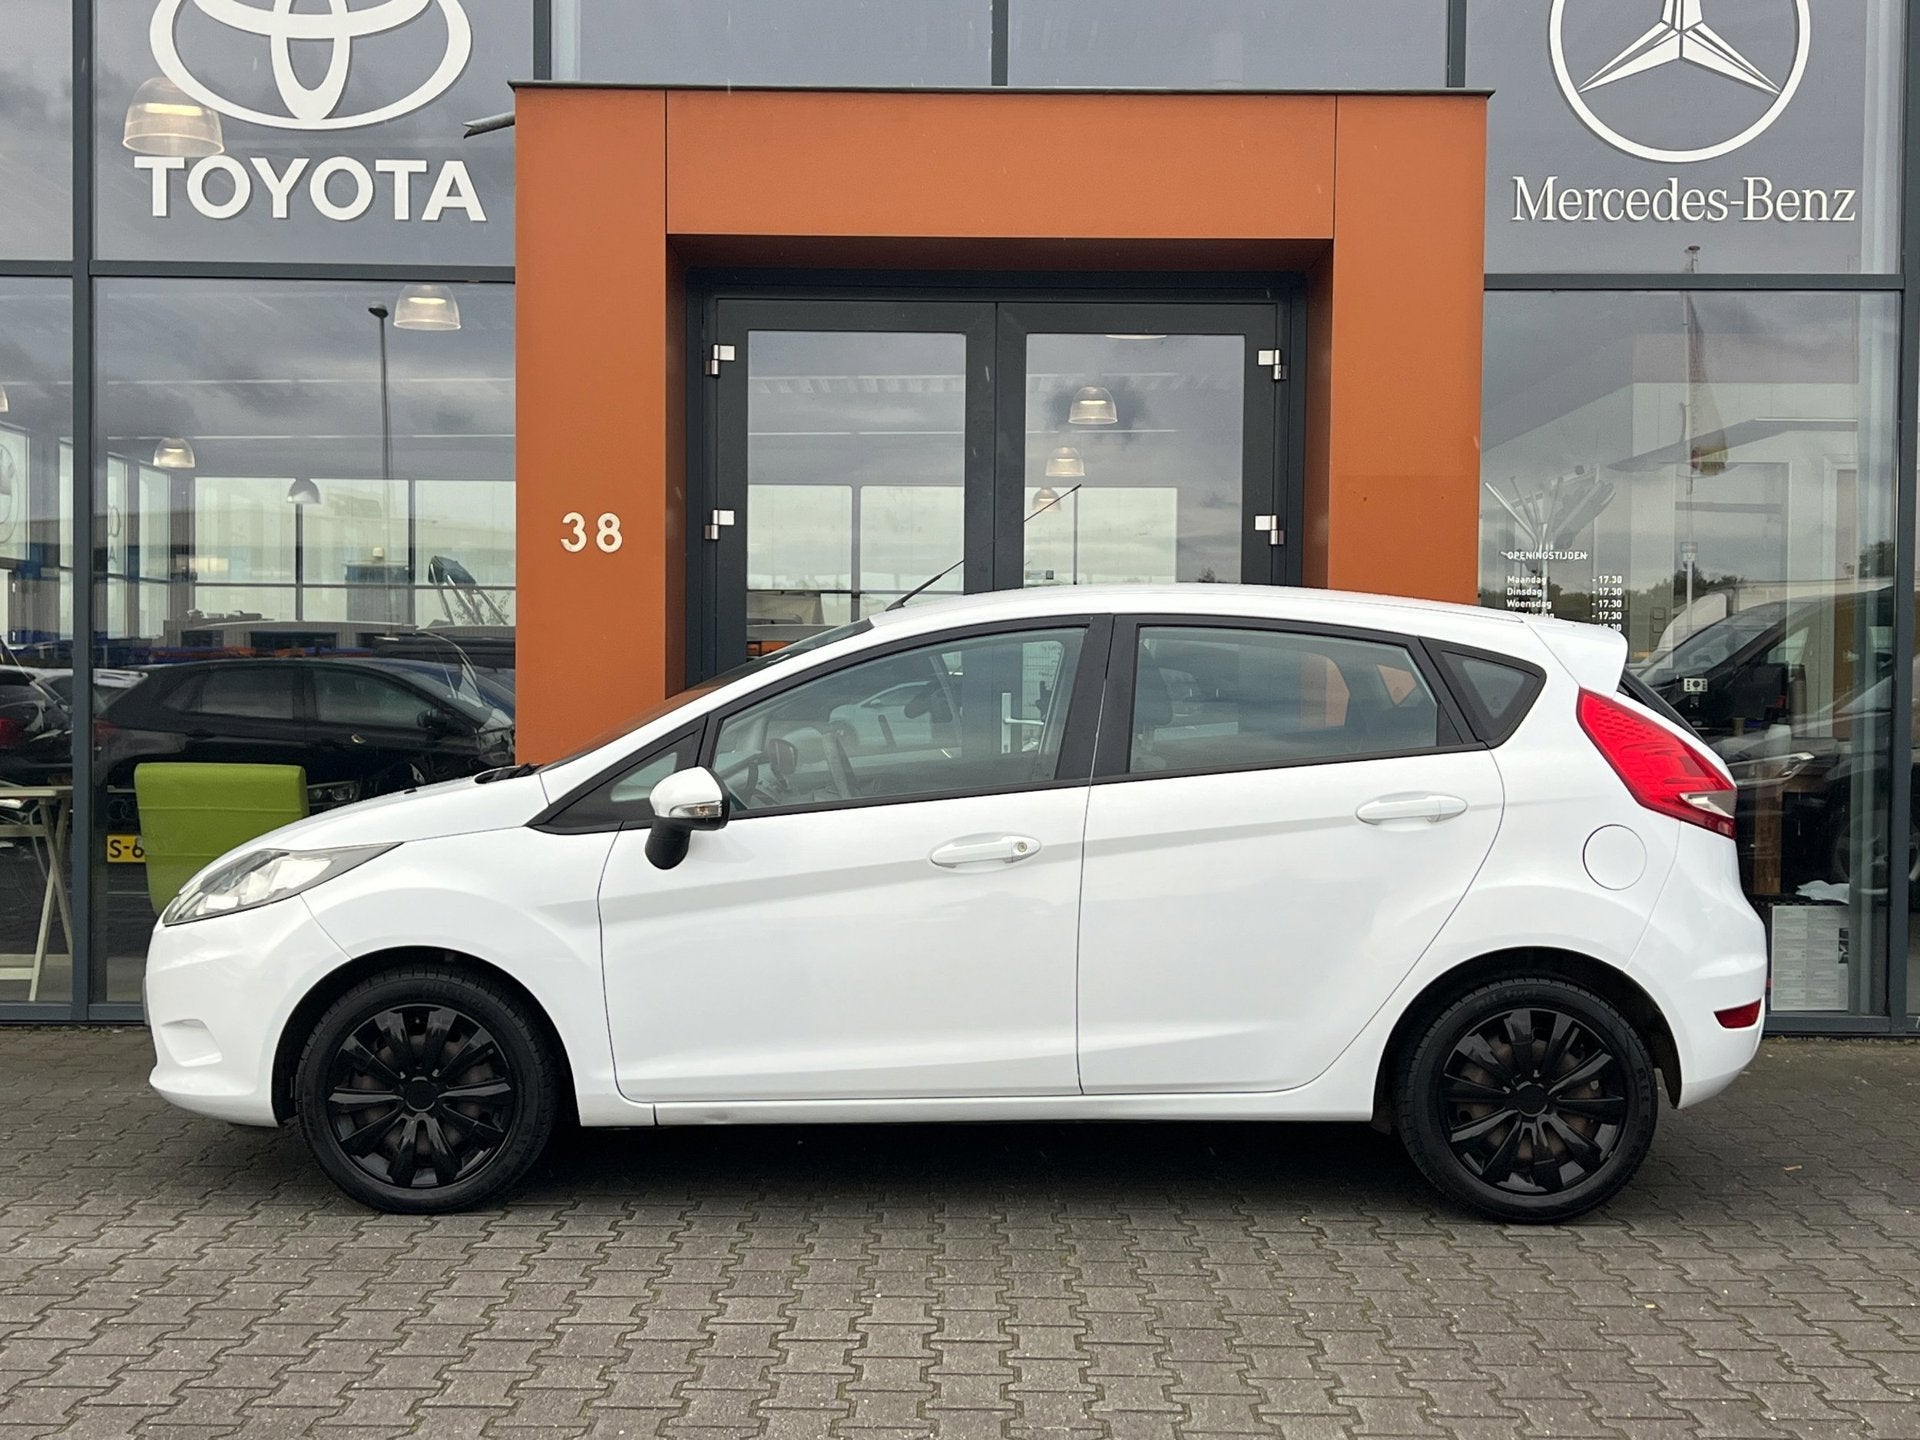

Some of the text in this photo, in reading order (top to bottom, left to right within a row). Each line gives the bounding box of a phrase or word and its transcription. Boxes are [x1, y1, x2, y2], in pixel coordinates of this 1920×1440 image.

[134, 155, 487, 221] TOYOTA
[1511, 176, 1856, 222] Mercedes-Benz
[561, 512, 622, 552] 38
[1507, 551, 1587, 560] OPENINGSTIJDEN
[1507, 576, 1547, 585] Maandag
[1599, 575, 1622, 584] 17.30
[1507, 588, 1543, 597] Dinsdag
[1599, 587, 1622, 596] 17.30
[1507, 600, 1552, 609] Woensdag
[1599, 600, 1622, 608] 17.30
[1599, 611, 1622, 620] 17.30
